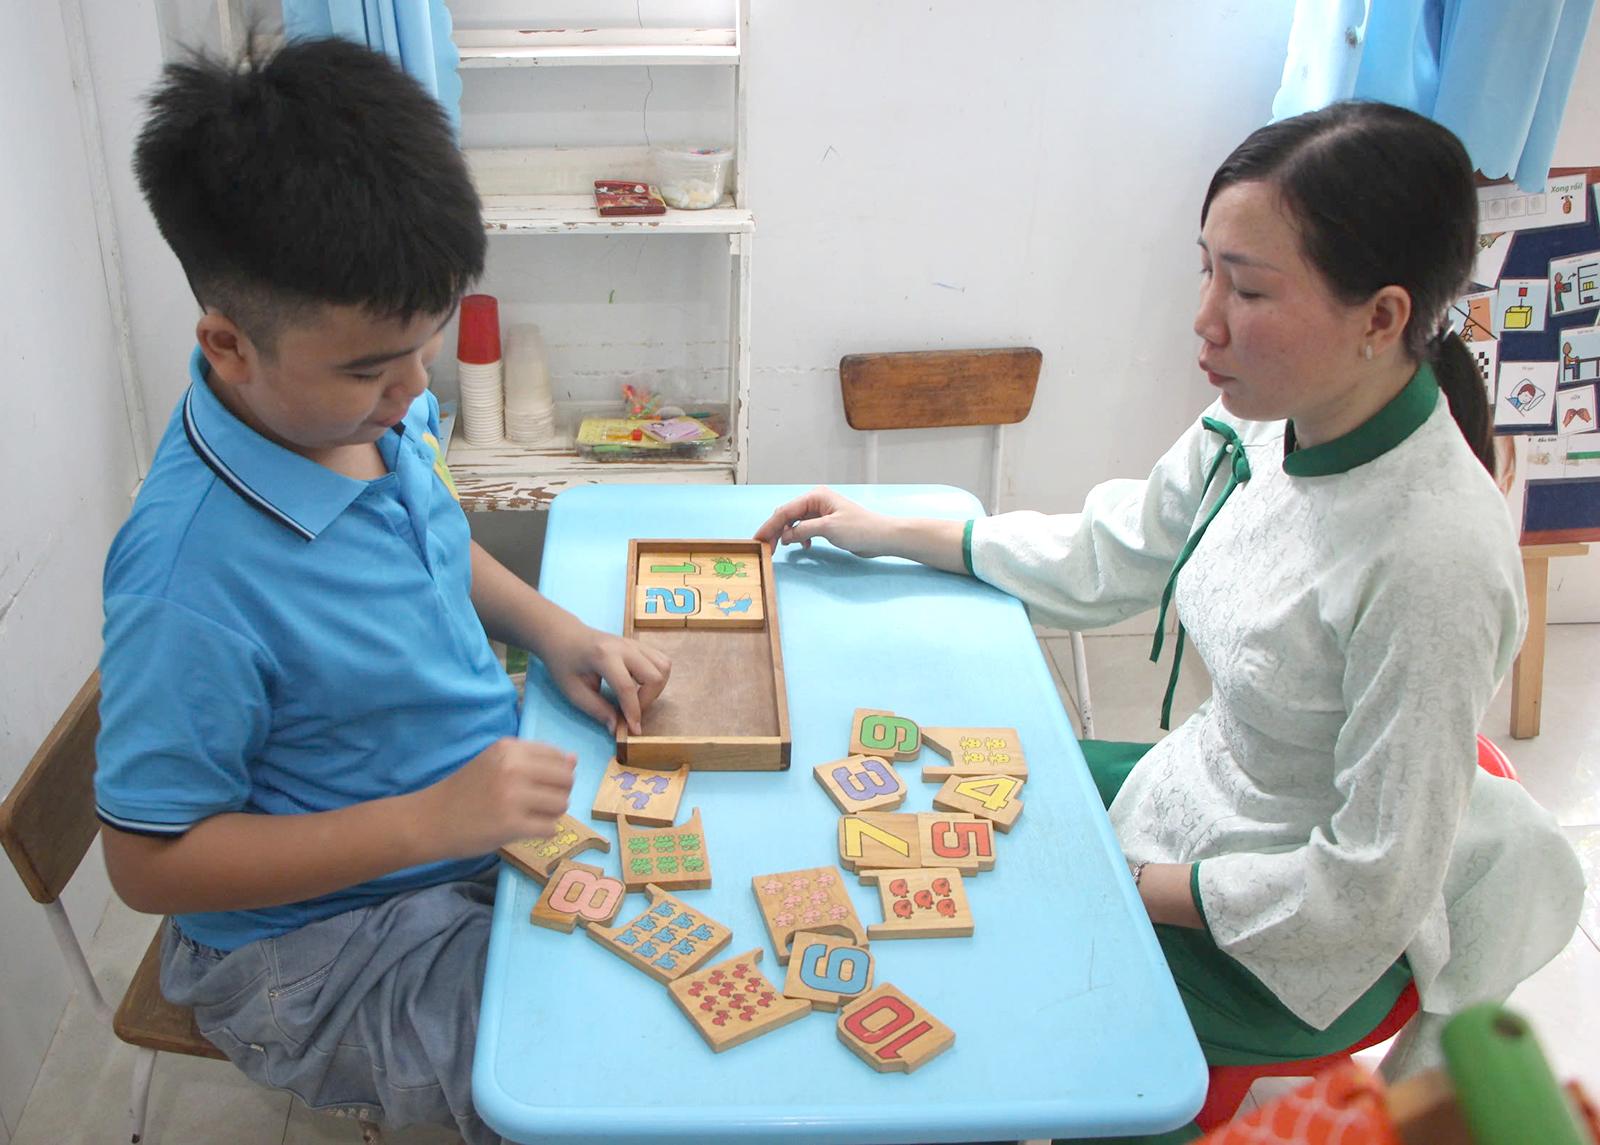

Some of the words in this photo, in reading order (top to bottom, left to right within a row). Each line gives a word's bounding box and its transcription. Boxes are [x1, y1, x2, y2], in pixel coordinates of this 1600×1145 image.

[1551, 185, 1569, 194] Xong
[650, 562, 696, 573] 1
[645, 587, 695, 614] 2
[832, 759, 899, 800] 3
[954, 777, 1018, 811] 4
[844, 817, 910, 857] 7
[931, 821, 992, 858] 5
[548, 868, 624, 920] 8
[844, 995, 933, 1059] 10
